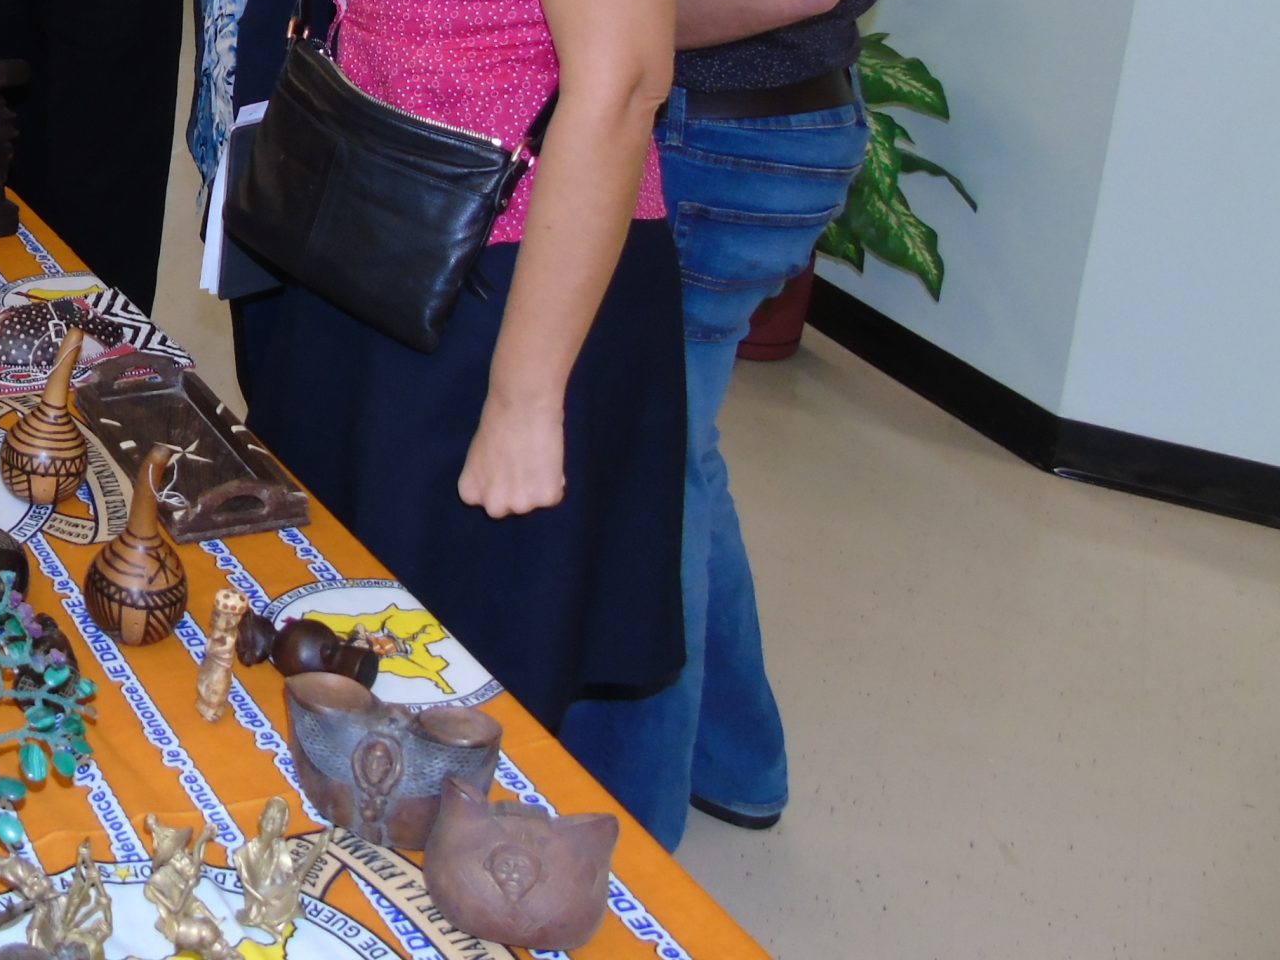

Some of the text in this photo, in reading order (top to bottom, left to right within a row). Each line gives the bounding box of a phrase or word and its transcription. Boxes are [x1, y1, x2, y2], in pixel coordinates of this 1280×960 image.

[220, 556, 239, 570] Je
[300, 547, 319, 560] Je
[57, 579, 75, 594] Je
[64, 594, 118, 663] DENONCE.
[107, 663, 131, 682] JE
[124, 681, 173, 746] dénonce.
[259, 731, 281, 749] Je
[166, 748, 188, 767] Je
[76, 762, 96, 782] Je
[627, 916, 664, 941] JE
[359, 940, 389, 960] DE
